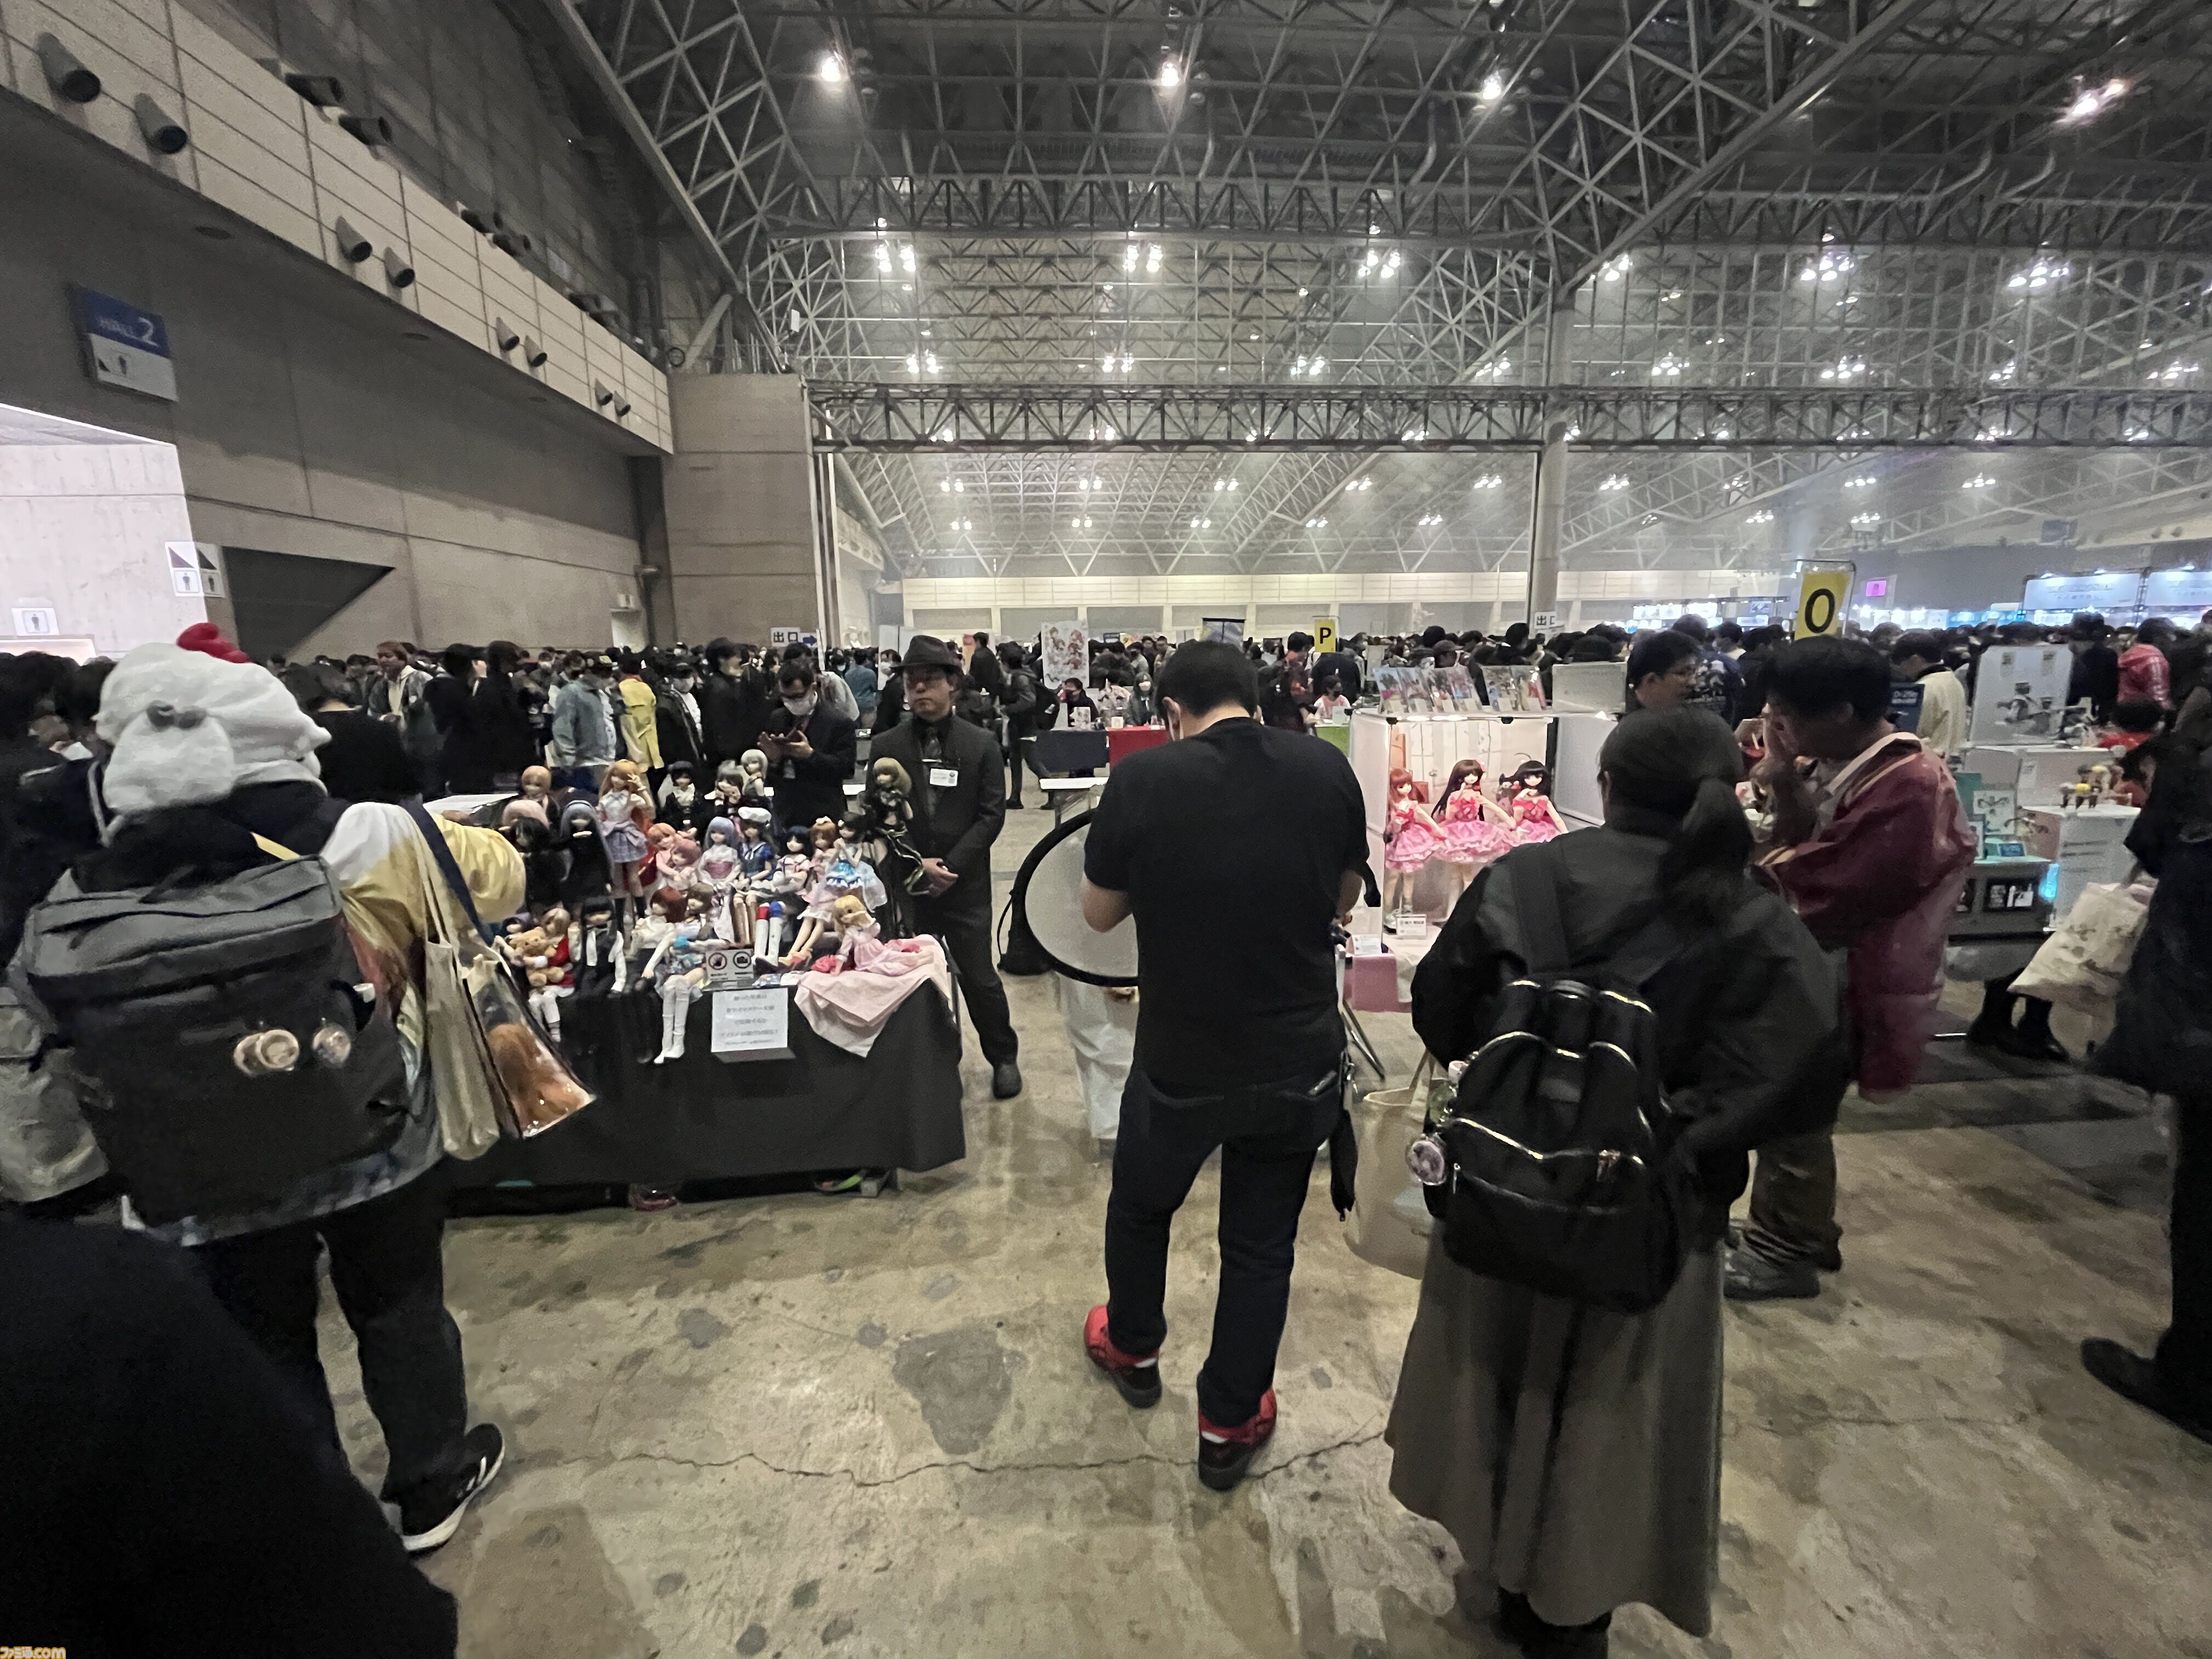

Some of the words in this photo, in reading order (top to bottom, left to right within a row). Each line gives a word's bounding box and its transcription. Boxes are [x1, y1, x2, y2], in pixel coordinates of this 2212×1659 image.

[138, 315, 160, 347] 2
[773, 631, 798, 643] 出口
[1320, 628, 1331, 644] P
